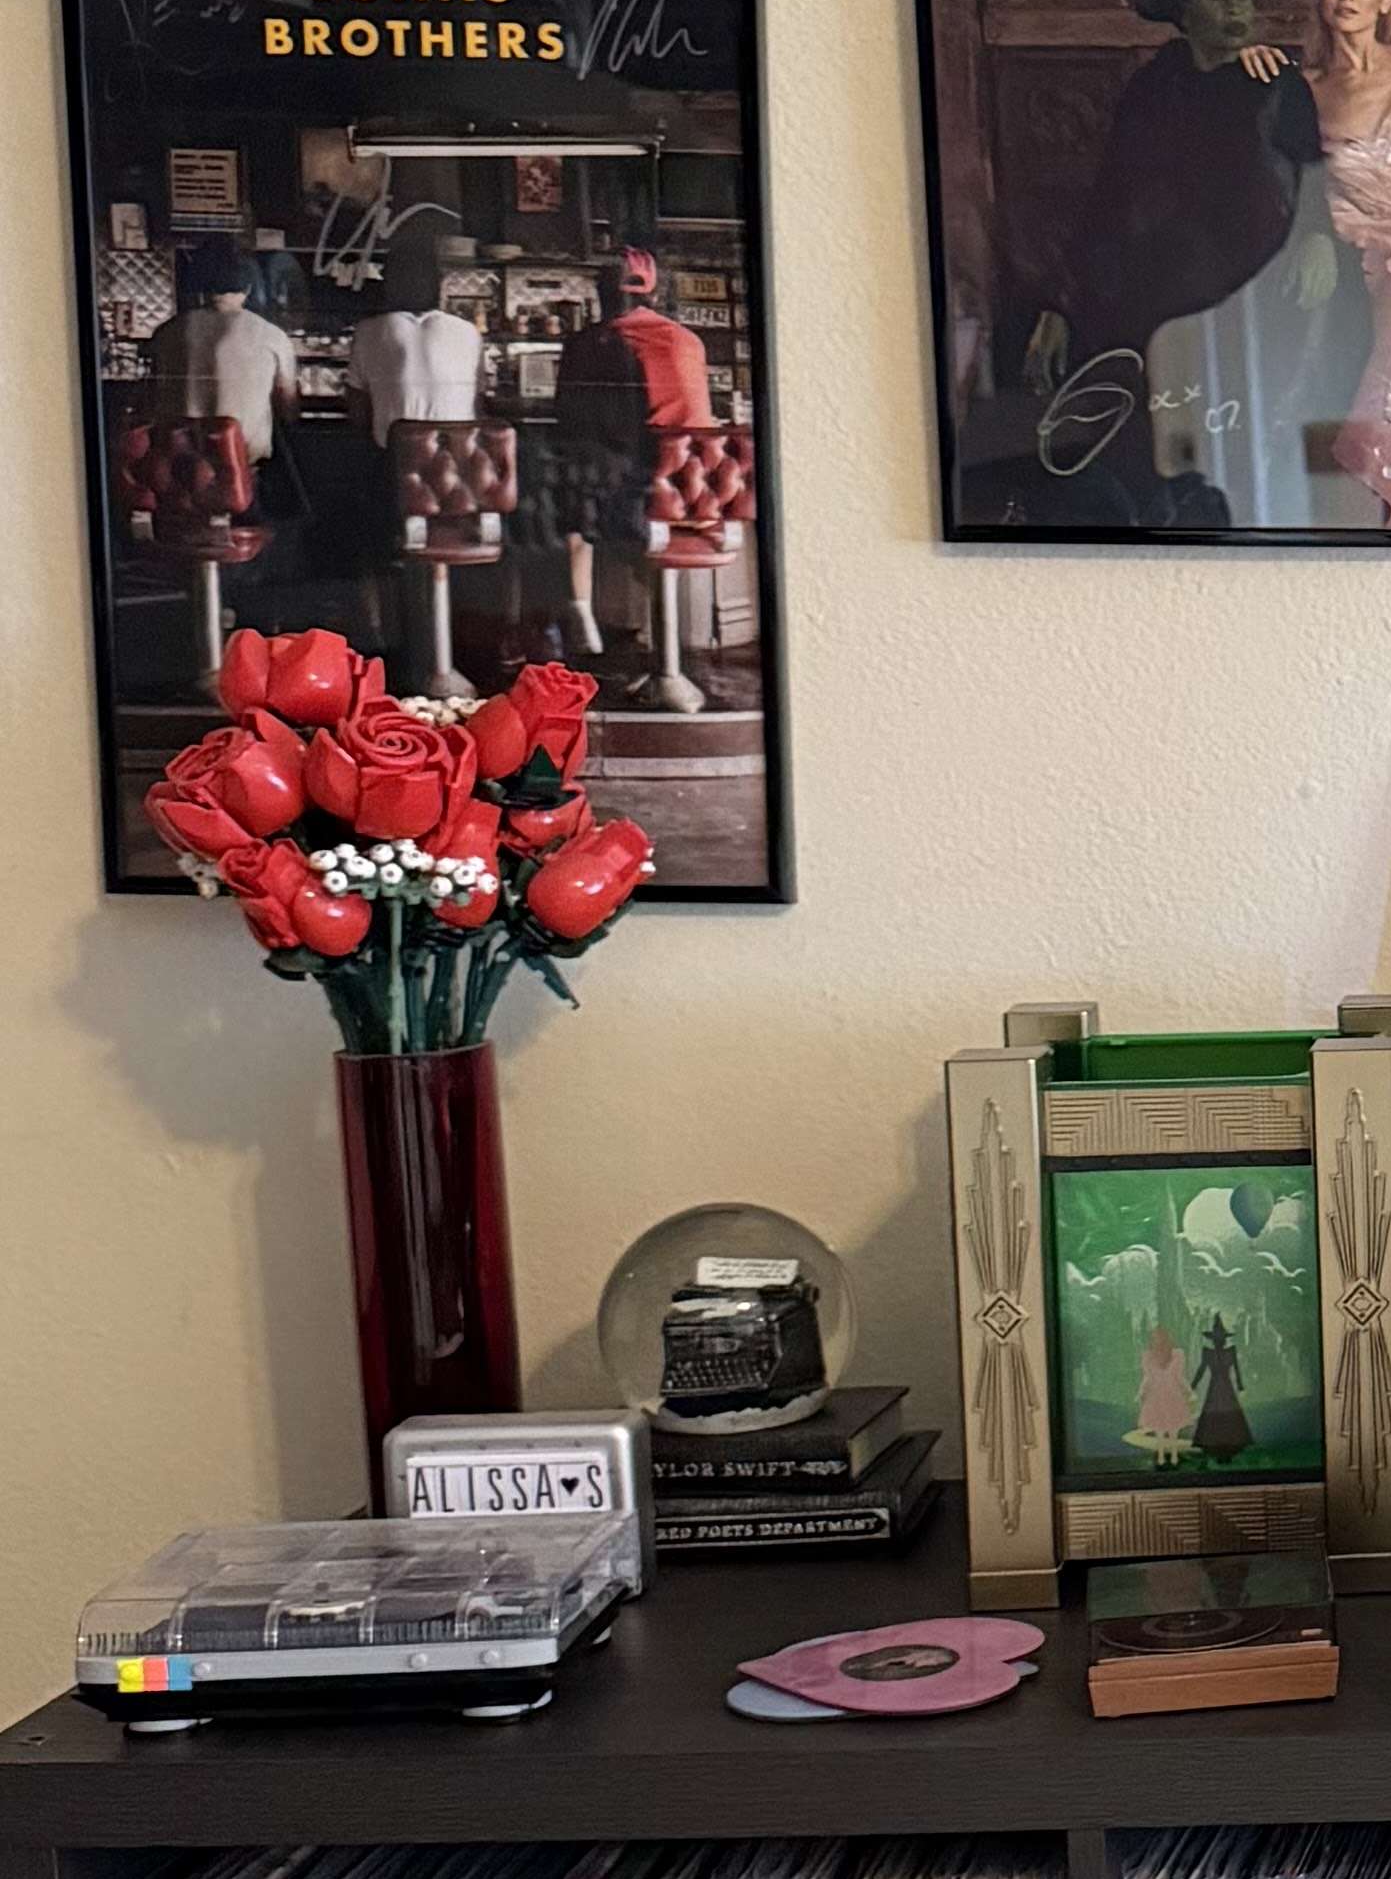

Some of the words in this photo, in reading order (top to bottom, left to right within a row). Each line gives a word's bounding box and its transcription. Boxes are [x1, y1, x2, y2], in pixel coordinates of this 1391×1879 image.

[263, 17, 565, 61] BROTHERS
[721, 1460, 796, 1477] SWIFT
[410, 1463, 556, 1514] ALISSA
[699, 1523, 754, 1539] POETS
[757, 1517, 879, 1537] DEPARTMENT
